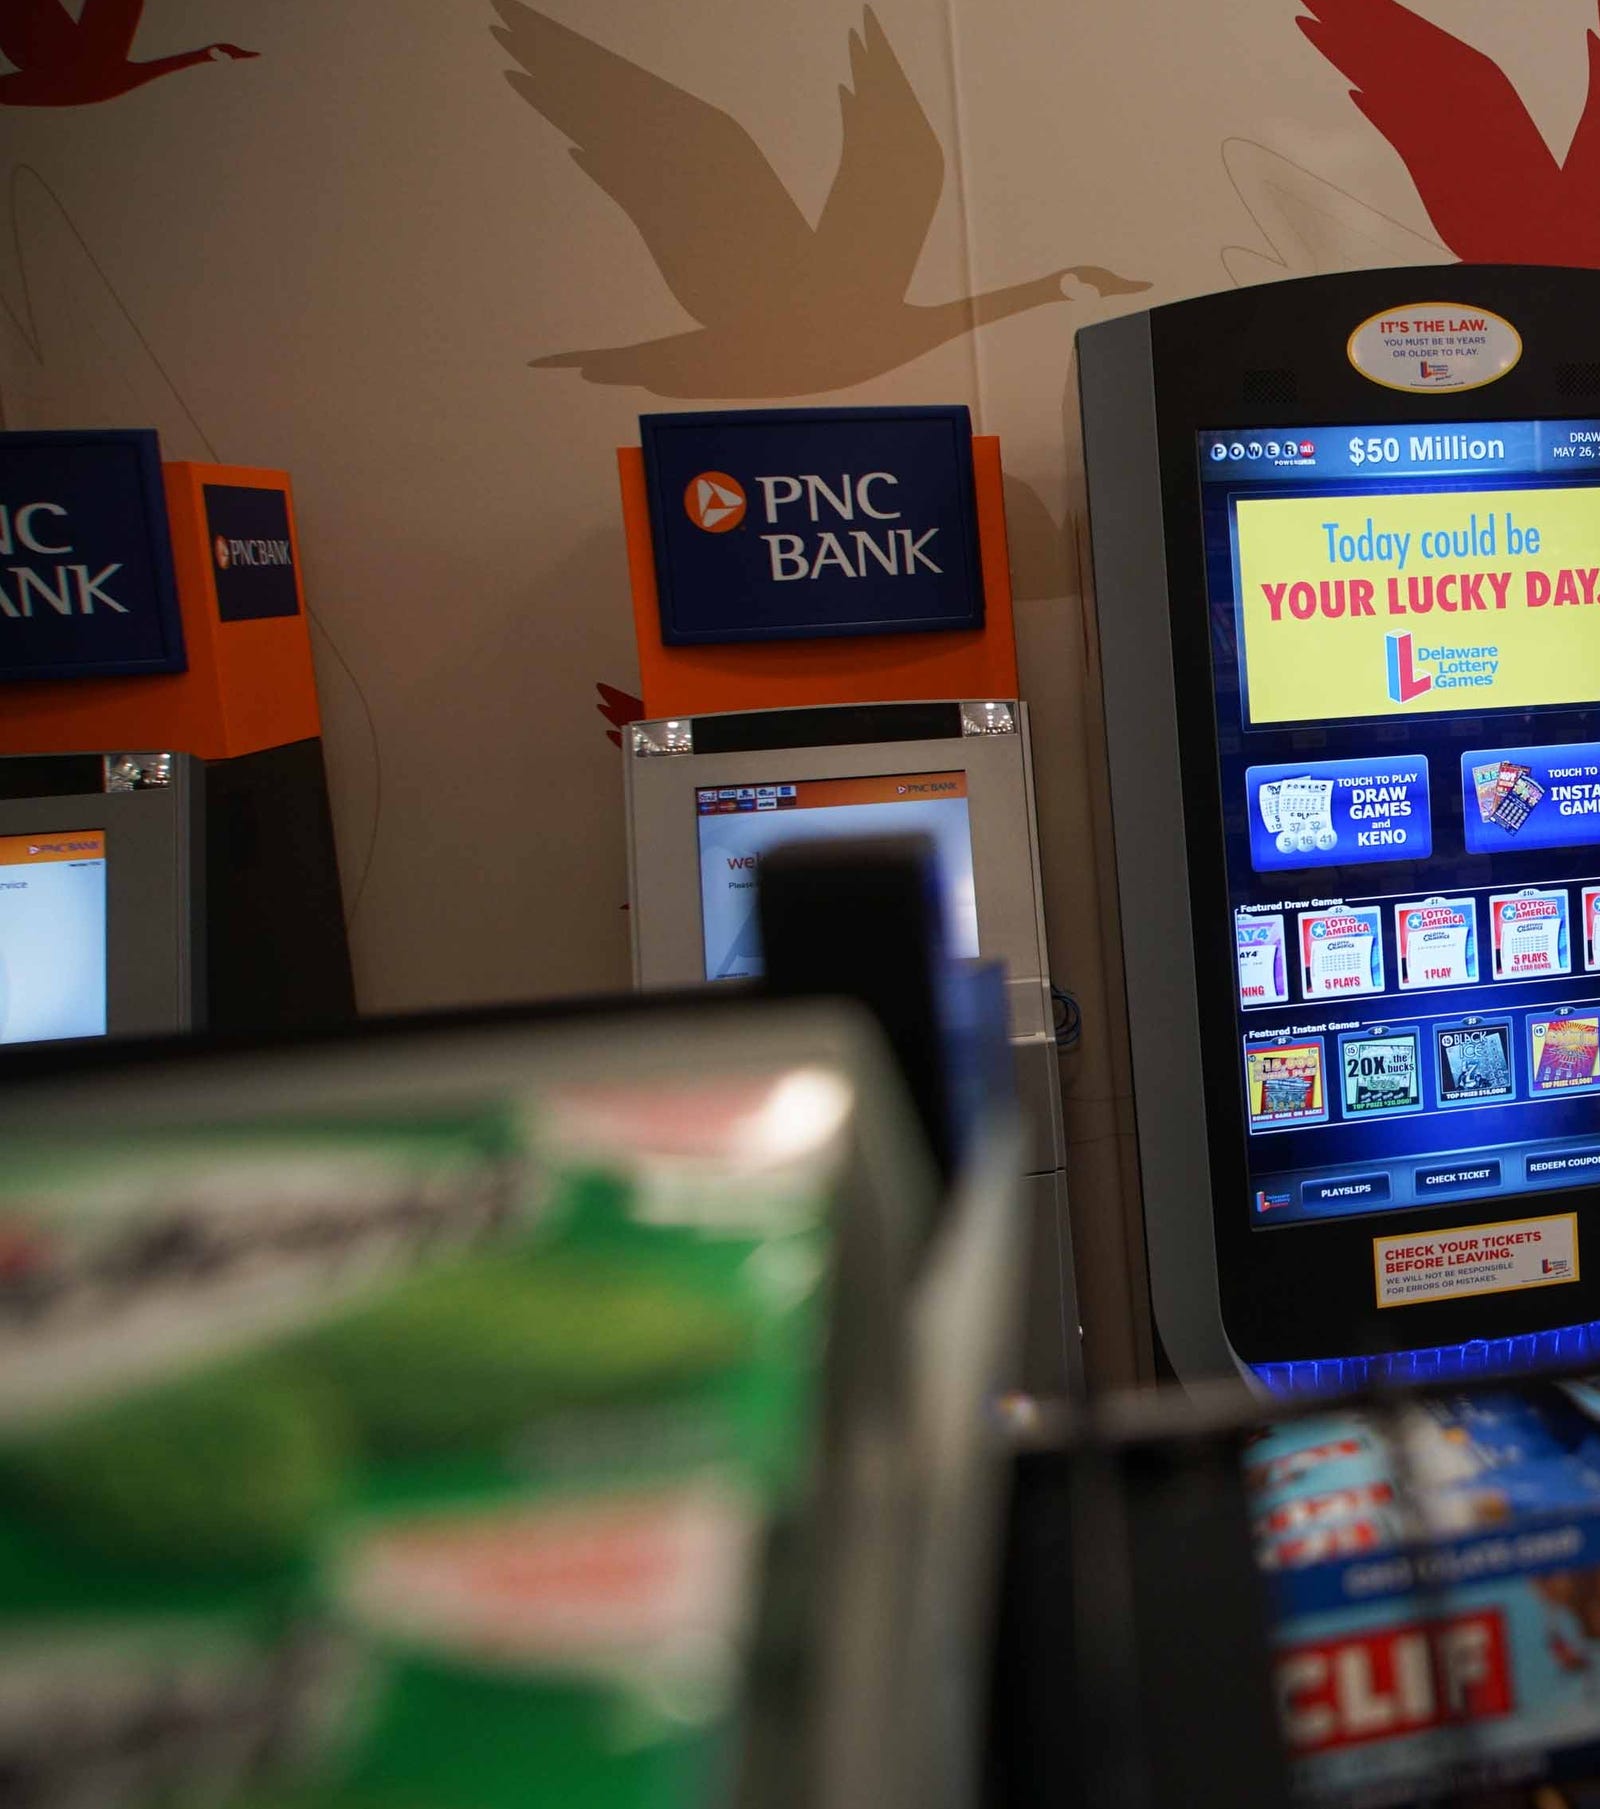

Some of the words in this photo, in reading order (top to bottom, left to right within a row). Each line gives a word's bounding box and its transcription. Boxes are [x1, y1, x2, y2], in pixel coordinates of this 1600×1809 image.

[1380, 321, 1410, 333] IT'S
[1413, 320, 1445, 332] THE
[1449, 319, 1488, 332] LAW.
[1384, 337, 1403, 347] YOU
[1405, 337, 1429, 346] MUST
[1431, 336, 1444, 346] BE
[1457, 336, 1486, 345] YEARS
[1392, 349, 1406, 358] OR
[1408, 348, 1438, 358] OLDER
[1441, 348, 1453, 357] TO
[1349, 436, 1400, 467] $50
[1409, 434, 1505, 462] Million
[1553, 447, 1576, 458] MAY
[1579, 446, 1596, 459] 26,
[755, 471, 901, 523] PNC
[1321, 517, 1411, 570] Today
[1421, 512, 1496, 559] could
[1506, 512, 1541, 555] be
[760, 527, 943, 581] BANK
[0, 562, 131, 618] NK
[1260, 578, 1377, 621] YOUR
[1386, 571, 1513, 615] LUCKY
[1417, 645, 1499, 662] Delaware
[1438, 659, 1499, 675] Lottery
[1435, 673, 1493, 689] Games
[1548, 767, 1581, 779] TOUCH
[1584, 766, 1598, 777] TO
[1337, 776, 1374, 788] TOUCH
[1376, 775, 1390, 786] TO
[1391, 773, 1418, 785] PLAY
[1351, 786, 1407, 803] DRAW
[1349, 802, 1412, 820] GAMES
[1371, 818, 1391, 829] and
[1357, 830, 1407, 847] KENO
[1240, 902, 1282, 913] Featured
[1284, 900, 1310, 910] Draw
[1311, 898, 1343, 907] Games
[1515, 900, 1545, 911] LOTTO
[1516, 906, 1558, 919] AMERICA
[1421, 909, 1452, 920] LOTTO
[1422, 915, 1465, 927] AMERICA
[1325, 917, 1356, 929] LOTTO
[1326, 924, 1370, 936] AMERICA
[1513, 955, 1520, 965] 5
[1521, 952, 1549, 963] PLAYS
[1430, 967, 1452, 978] PLAY
[1324, 979, 1331, 989] 5
[1333, 976, 1361, 988] PLAYS
[1249, 1028, 1290, 1039] Featured
[1292, 1024, 1327, 1035] Instant
[1328, 1020, 1360, 1031] Games
[1453, 1031, 1488, 1044] BLACK
[1459, 1044, 1484, 1058] ICE
[1347, 1055, 1386, 1078] 20X
[1393, 1054, 1408, 1064] the
[1387, 1062, 1414, 1074] bucks
[1530, 1159, 1566, 1174] REDEEM
[1425, 1172, 1453, 1186] CHECK
[1455, 1169, 1491, 1183] TICKET
[1320, 1183, 1372, 1199] PLAYSLIPS
[1384, 1244, 1435, 1262] CHECK
[1438, 1238, 1479, 1256] YOUR
[1482, 1230, 1543, 1250] TICKETS
[1385, 1256, 1444, 1274] BEFORE
[1448, 1247, 1515, 1267] LEAVING.
[1386, 1276, 1400, 1286] WE
[1401, 1274, 1422, 1285] WILL
[1425, 1271, 1443, 1282] NOT
[1445, 1269, 1456, 1279] BE
[1458, 1261, 1514, 1276] RESPONSIBLE
[1386, 1286, 1404, 1296] FOR
[1406, 1283, 1440, 1294] ERRORS
[1442, 1280, 1454, 1289] OR
